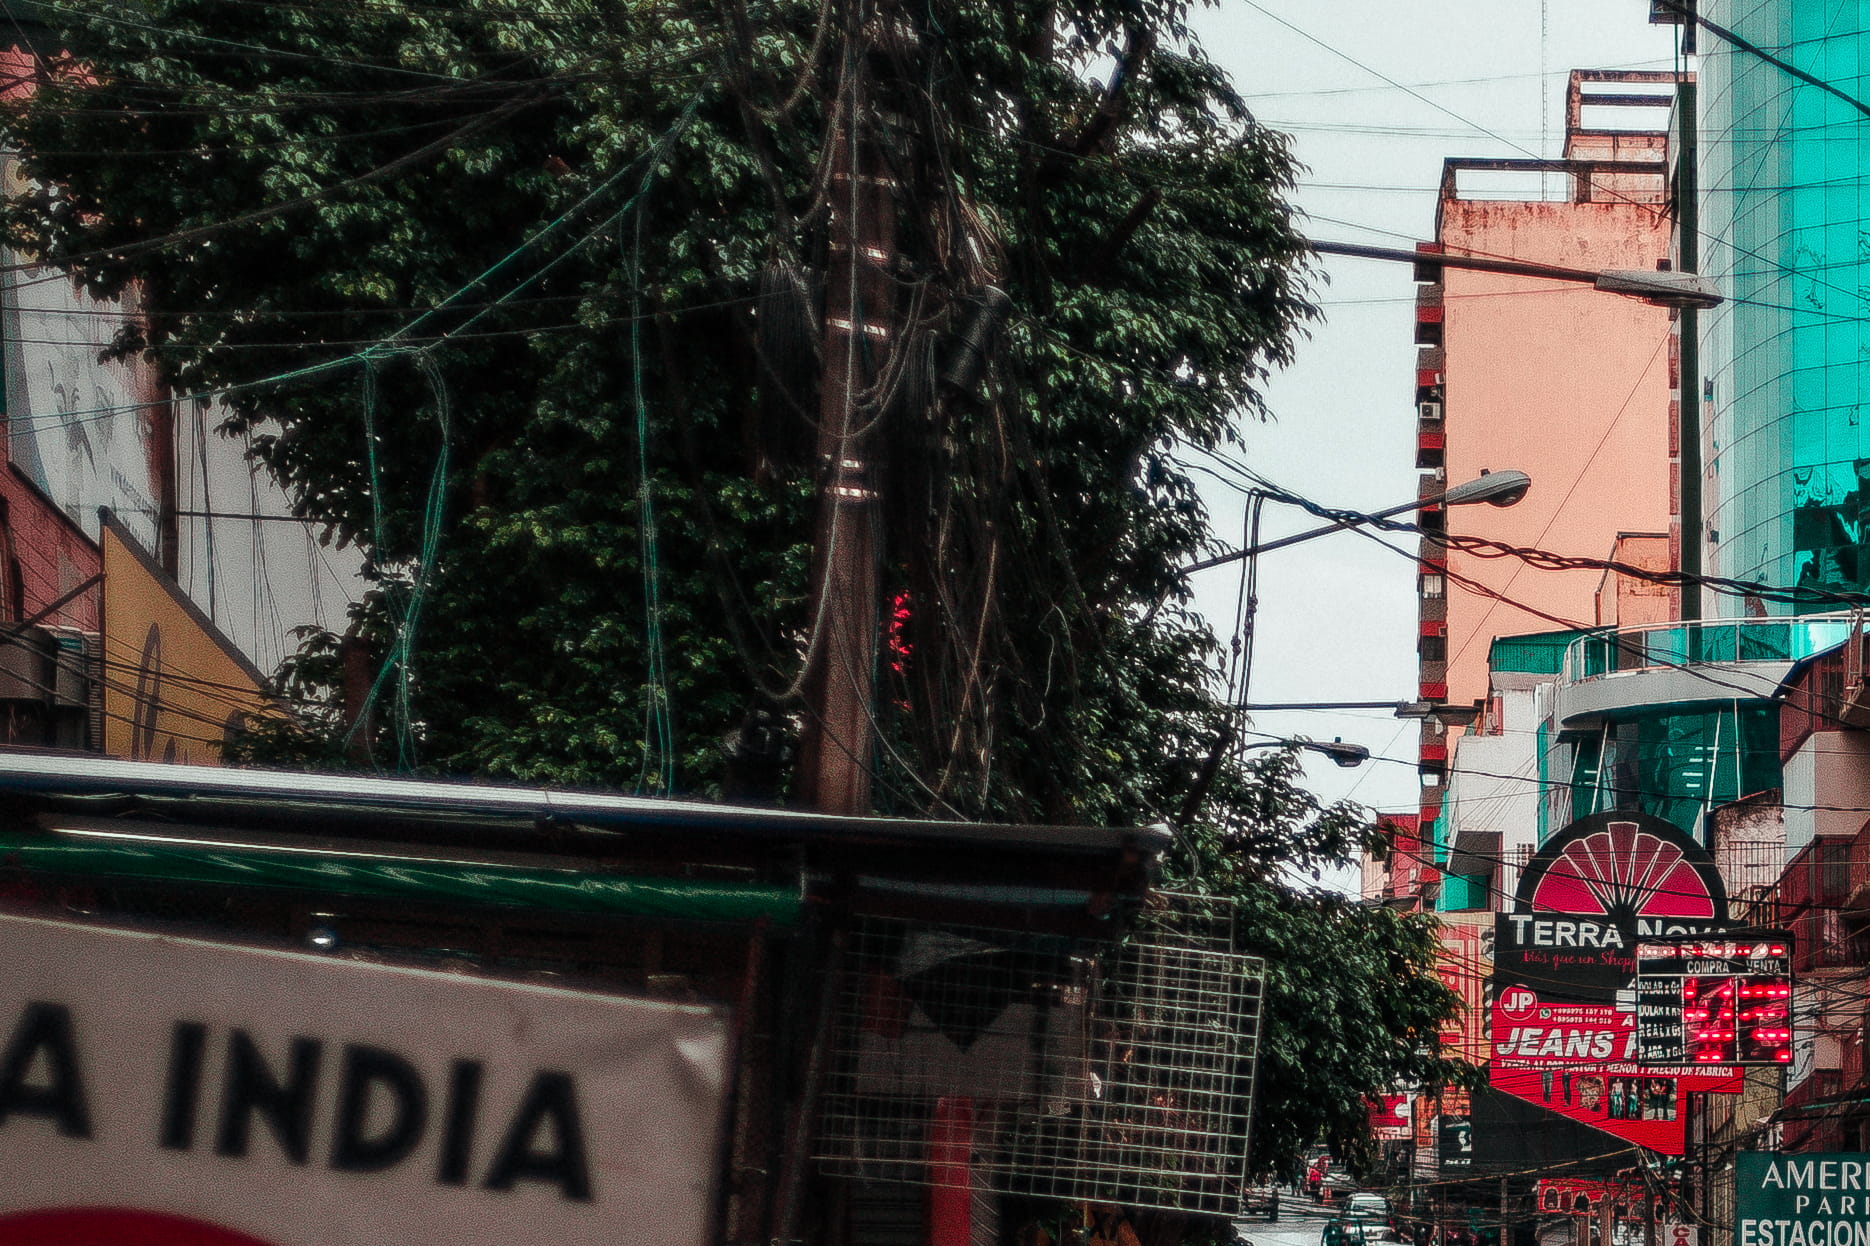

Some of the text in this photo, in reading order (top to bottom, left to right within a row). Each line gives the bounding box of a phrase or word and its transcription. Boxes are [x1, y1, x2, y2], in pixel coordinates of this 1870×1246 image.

[1508, 914, 1624, 949] TERRA
[1687, 960, 1782, 974] COMPRA VENTA
[1503, 992, 1534, 1012] JP
[1496, 1027, 1615, 1059] JEANS
[1606, 1062, 1638, 1075] MENOR
[157, 1019, 593, 1202] INDIA
